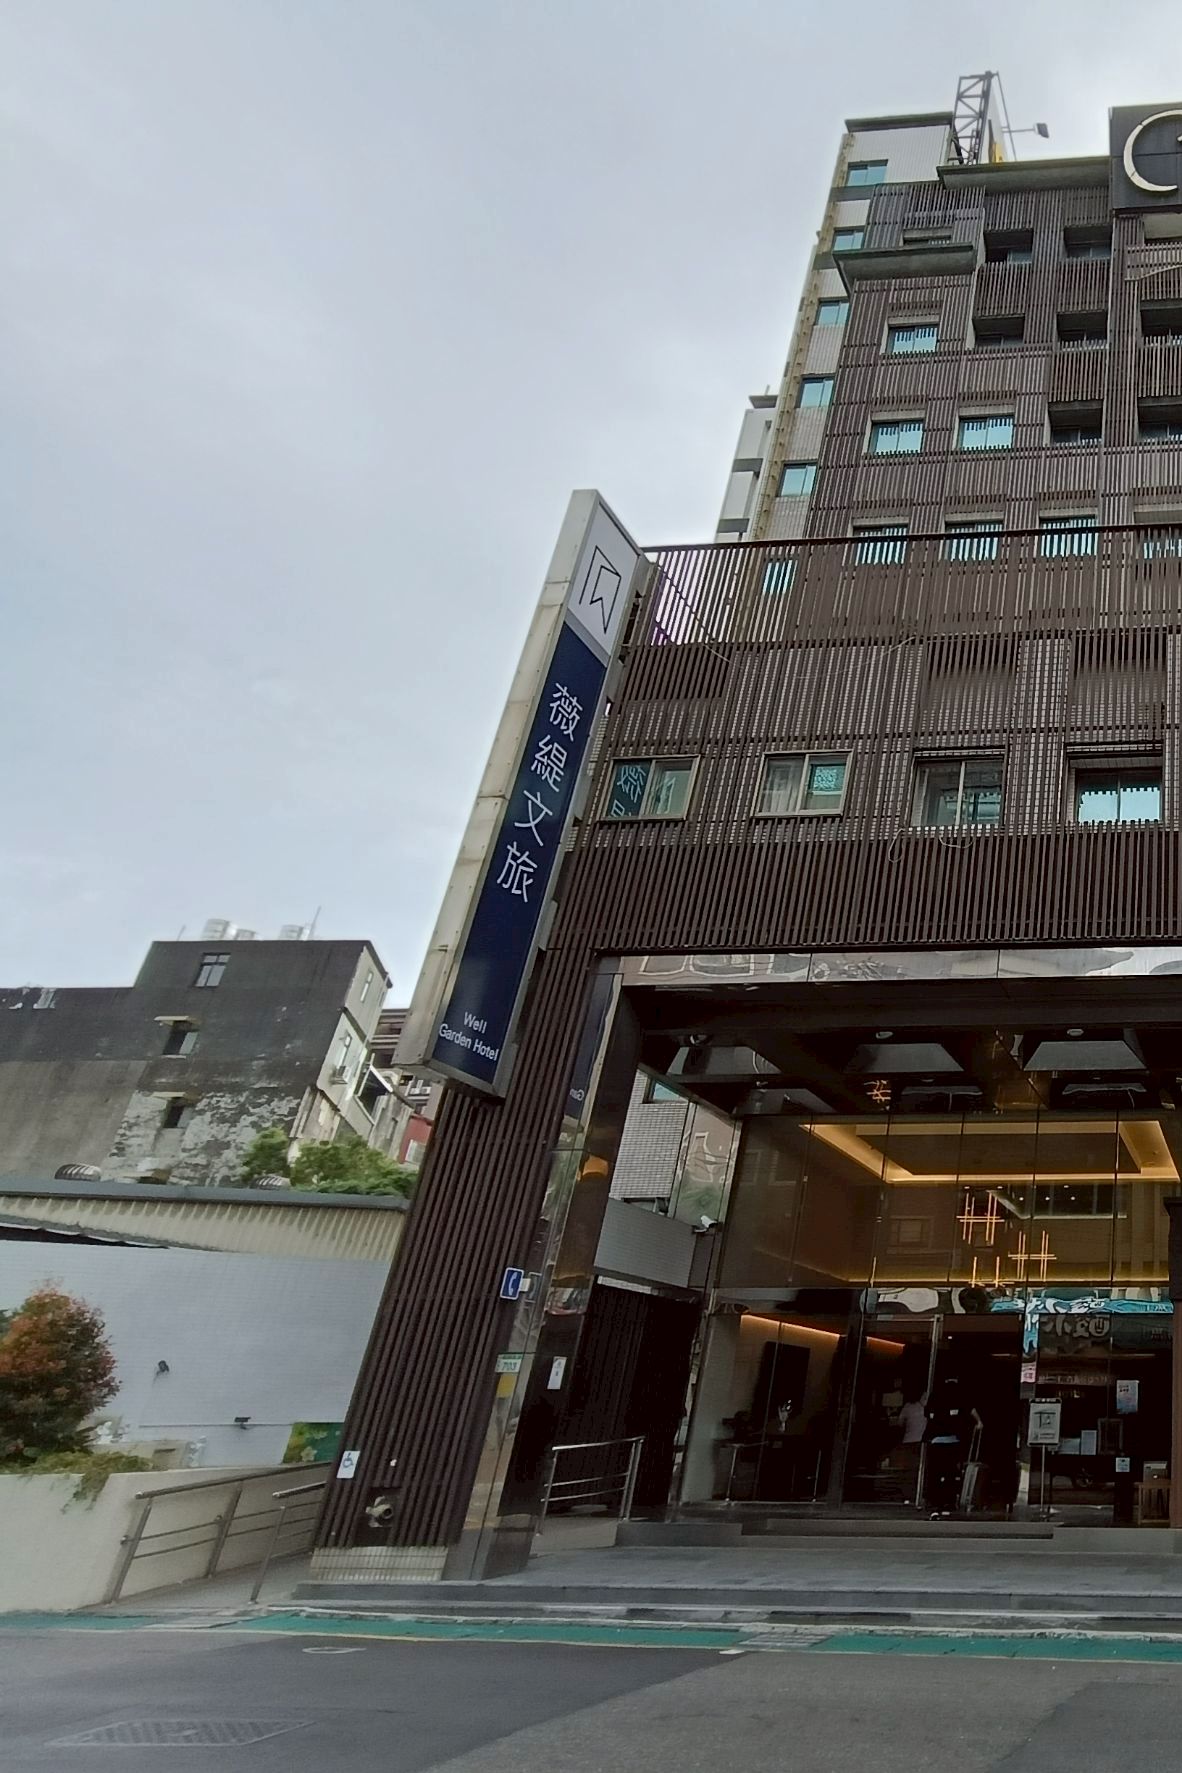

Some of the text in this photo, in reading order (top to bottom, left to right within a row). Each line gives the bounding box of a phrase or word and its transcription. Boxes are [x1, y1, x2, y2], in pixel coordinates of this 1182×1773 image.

[497, 682, 583, 903] 薇緹文旅
[463, 1011, 487, 1034] Well
[438, 1023, 499, 1061] Garden Hotel
